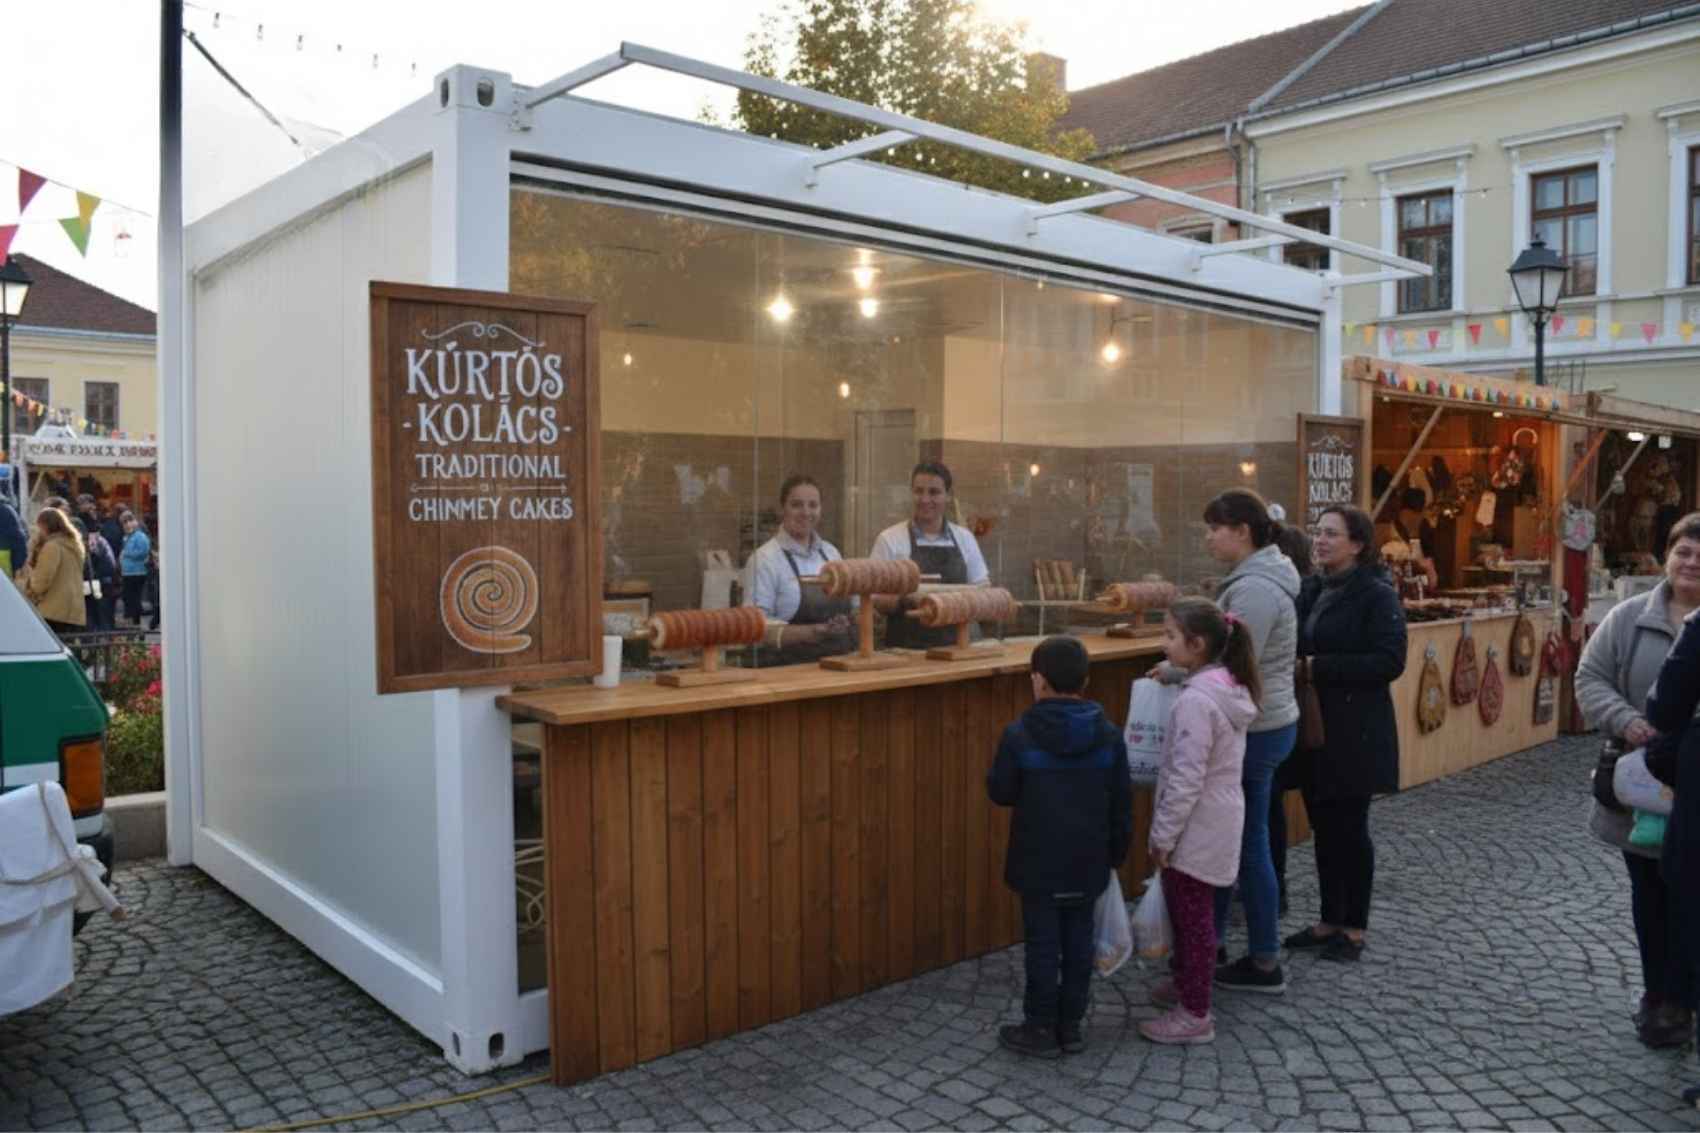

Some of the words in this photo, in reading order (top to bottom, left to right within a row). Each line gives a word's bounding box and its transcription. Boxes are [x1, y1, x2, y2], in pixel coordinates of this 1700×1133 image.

[416, 454, 566, 478] TRADITIONAL
[409, 498, 502, 521] CHINMEY
[509, 498, 573, 520] CAKES
